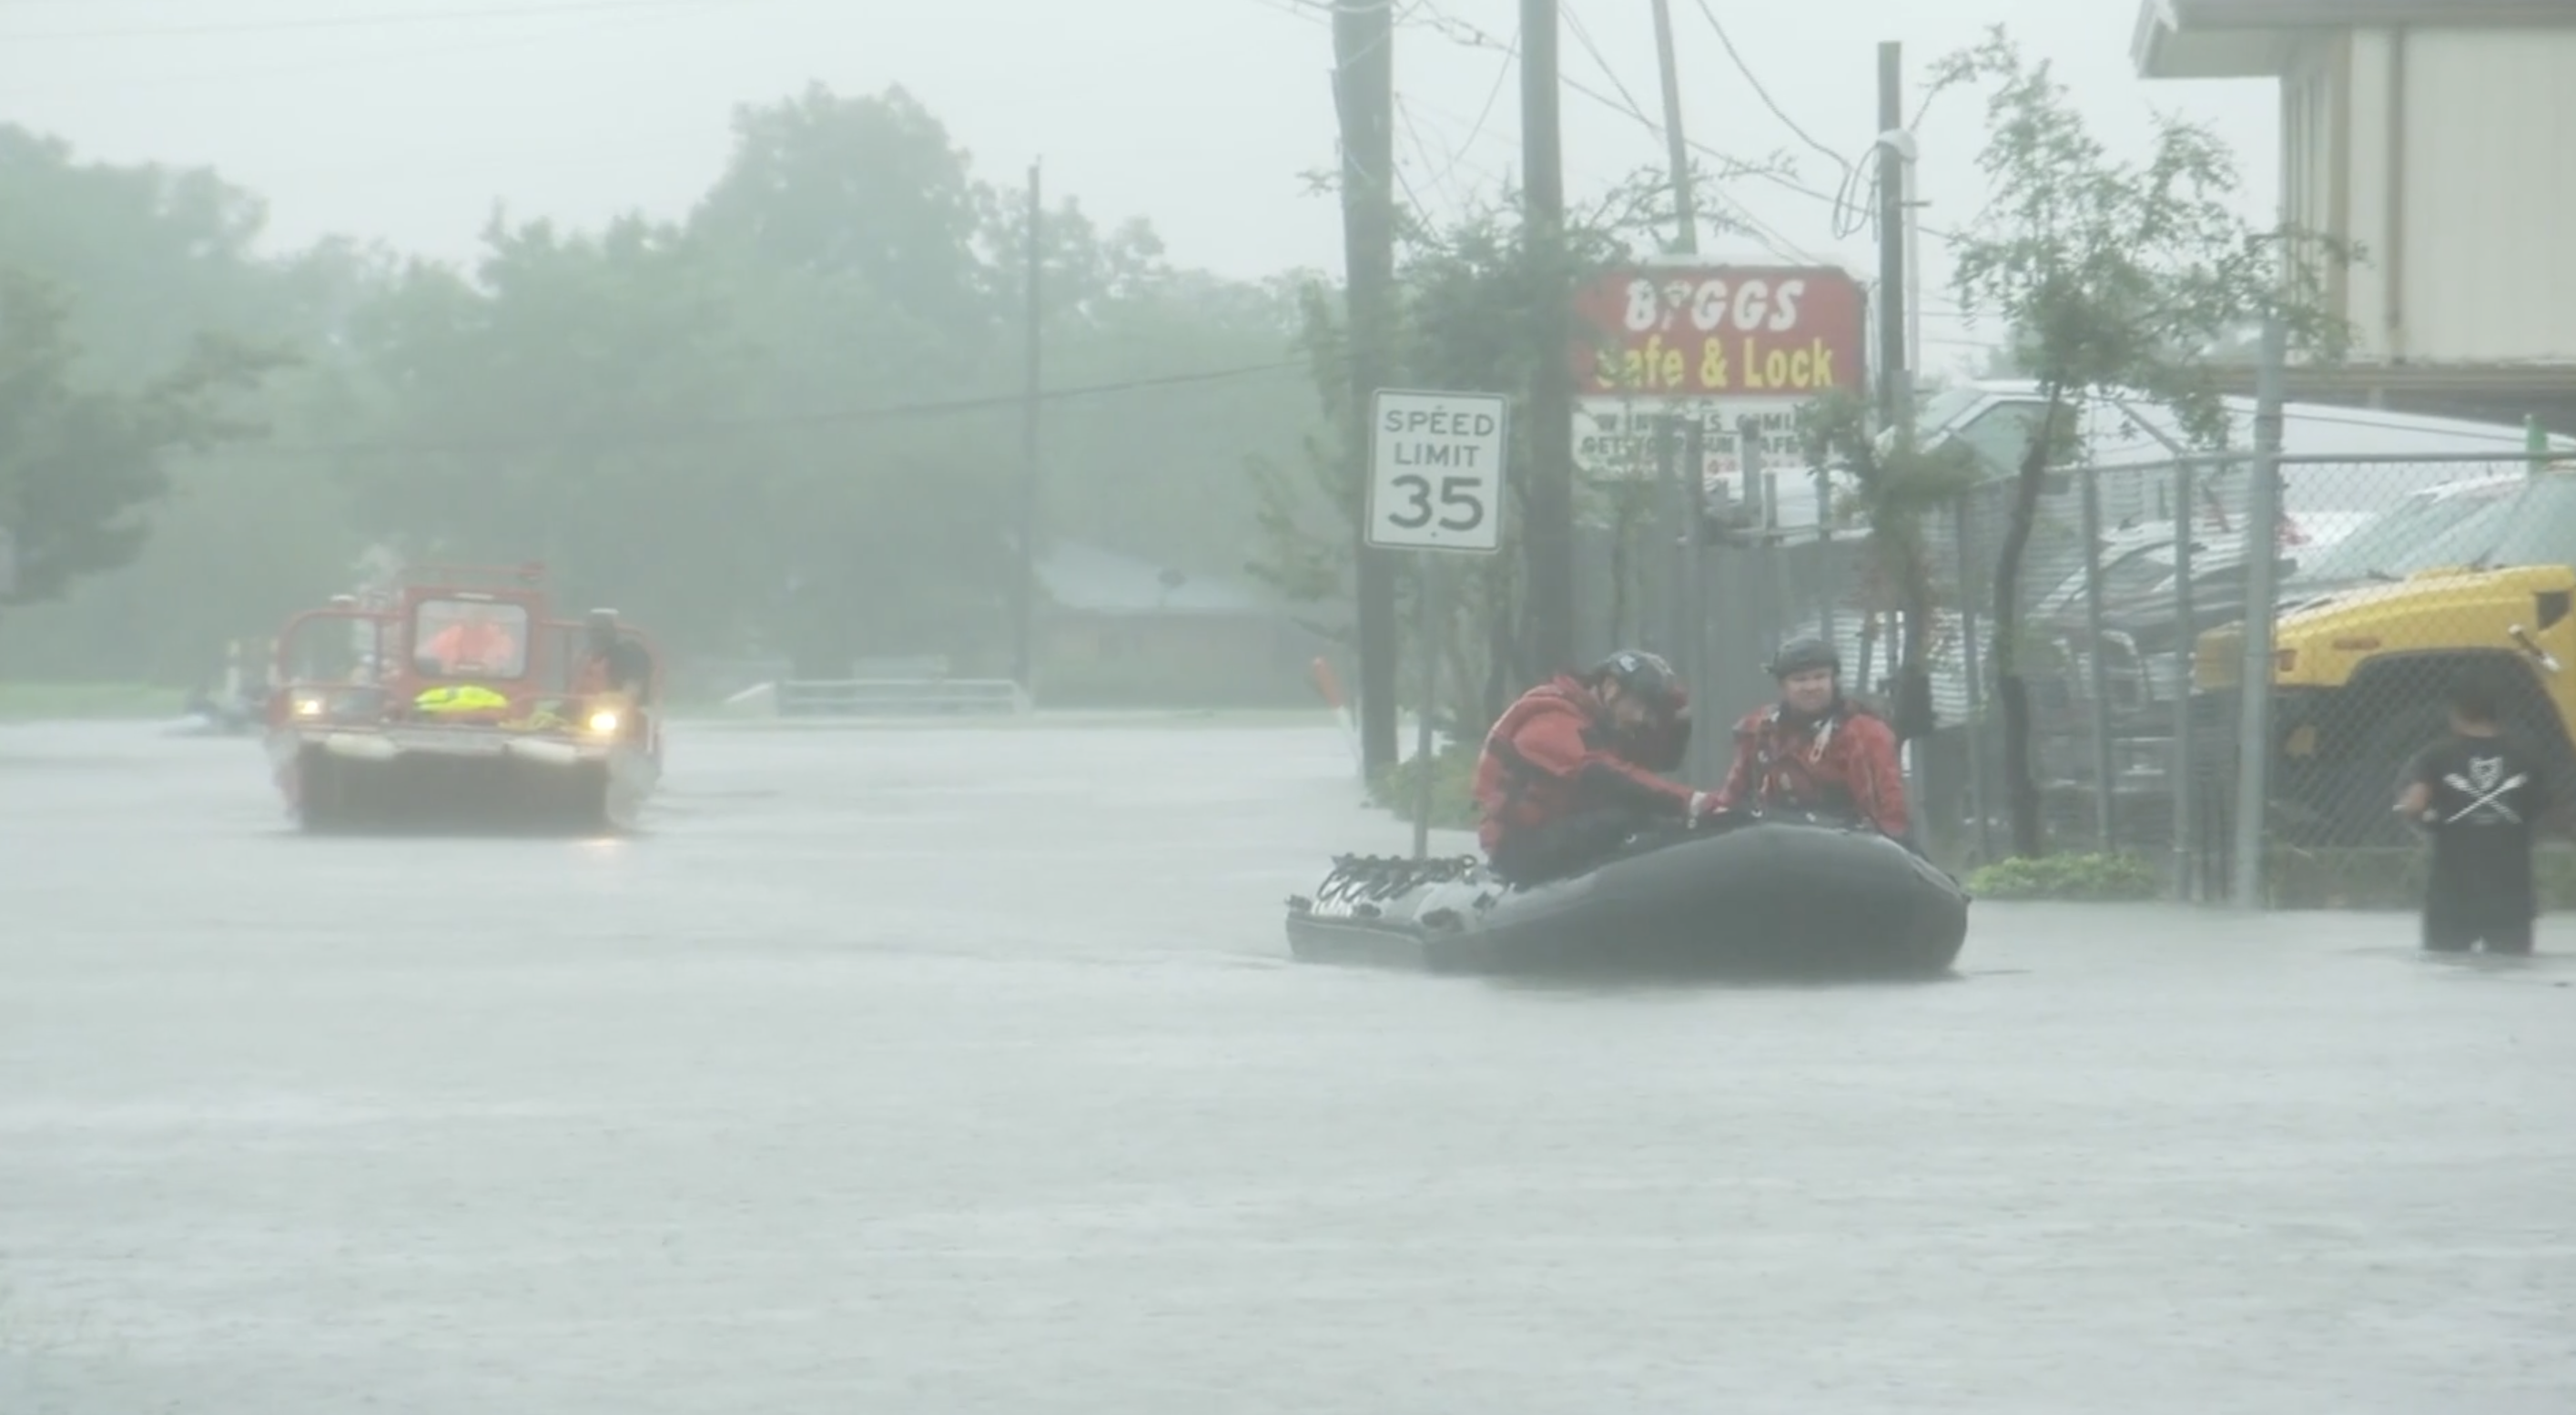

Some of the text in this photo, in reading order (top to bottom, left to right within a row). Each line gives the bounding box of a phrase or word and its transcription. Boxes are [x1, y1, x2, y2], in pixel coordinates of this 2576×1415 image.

[1699, 336, 1728, 389] &
[1742, 336, 1834, 389] Lock
[1384, 409, 1496, 437] SPEED
[1394, 442, 1482, 468] LIMIT
[1387, 473, 1486, 533] 35
